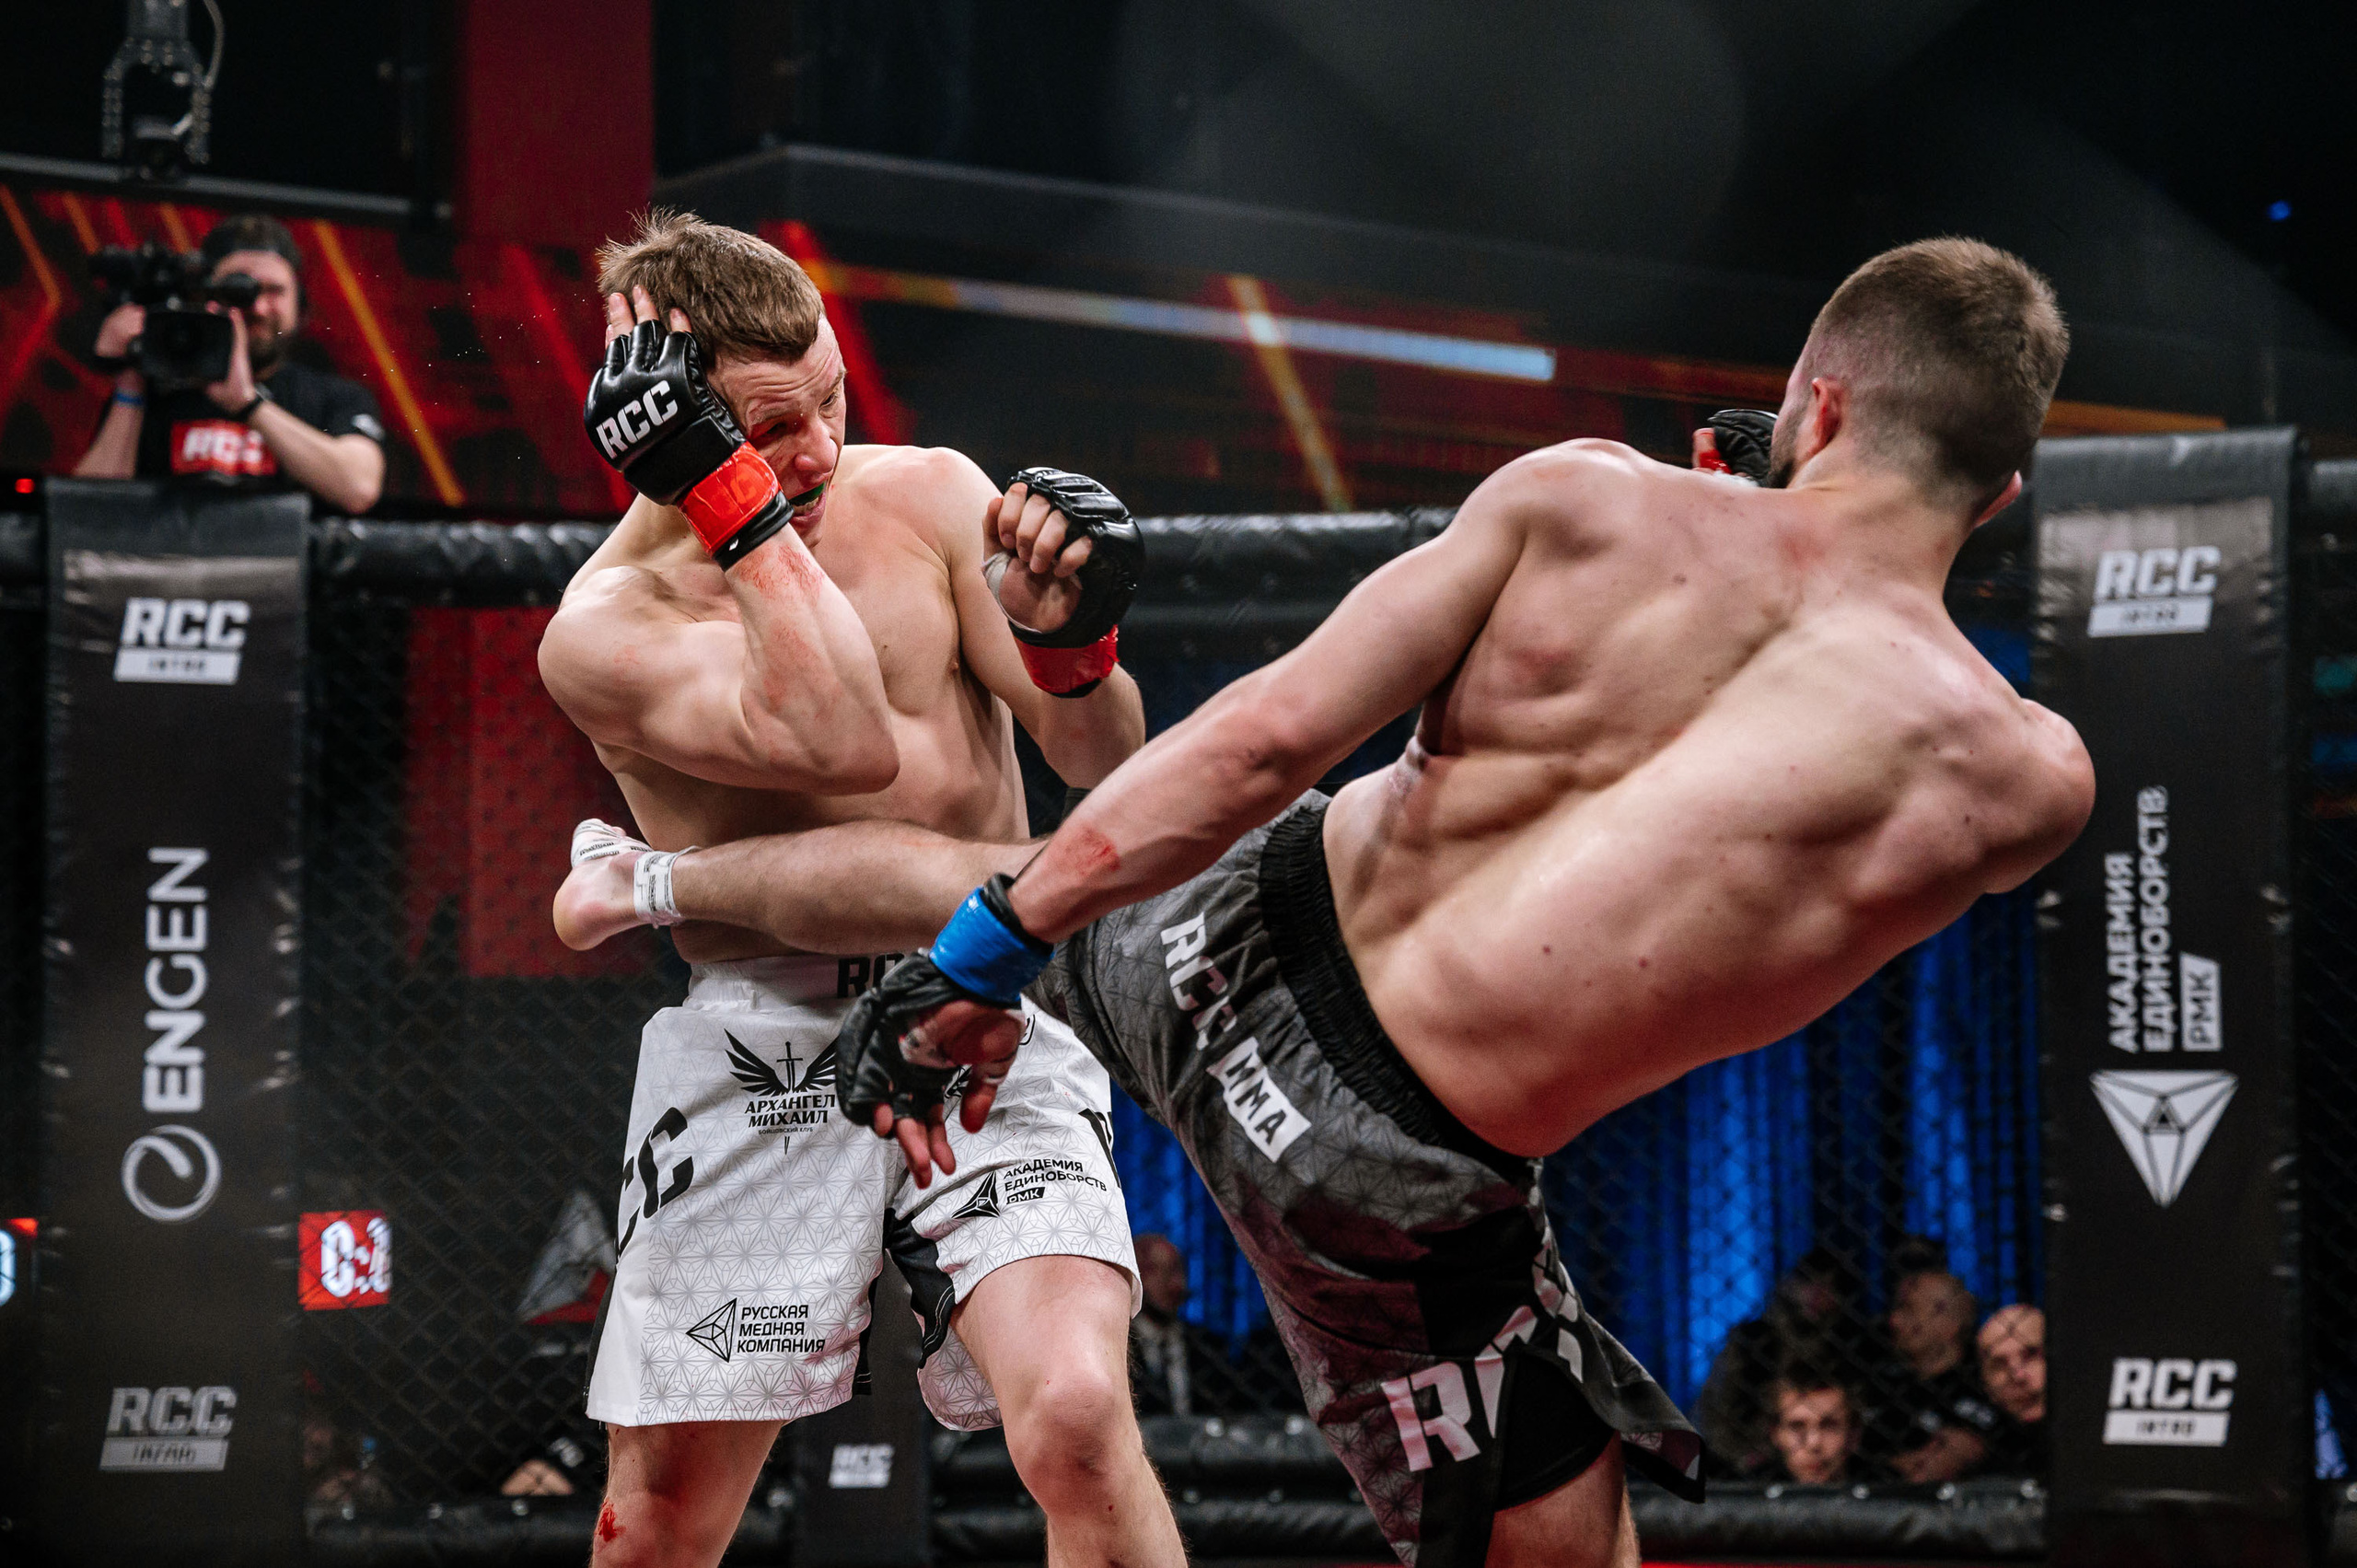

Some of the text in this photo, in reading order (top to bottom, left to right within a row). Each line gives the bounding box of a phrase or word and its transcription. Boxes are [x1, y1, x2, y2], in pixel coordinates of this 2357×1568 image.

[597, 380, 678, 459] RCC
[2095, 546, 2221, 598] RCC
[120, 598, 250, 646] RCC
[2137, 784, 2177, 1051] ЕДИНОБОРСТВ
[2105, 853, 2139, 1053] АКАДЕМИЯ
[143, 847, 209, 1112] ENGEN
[745, 1094, 835, 1114] АРХАНГЕЛ
[748, 1110, 828, 1128] МИХАИЛ
[1225, 1052, 1286, 1145] MMA
[1004, 1158, 1084, 1179] АКАДЕМИЯ
[1004, 1170, 1108, 1191] ЕДИНОБОРСТВ
[739, 1322, 805, 1337] МЕДНАЯ
[741, 1305, 808, 1320] РУССКАЯ
[737, 1339, 826, 1353] КОМПАНИЯ
[2108, 1356, 2237, 1410] RCC
[106, 1386, 237, 1435] RCC
